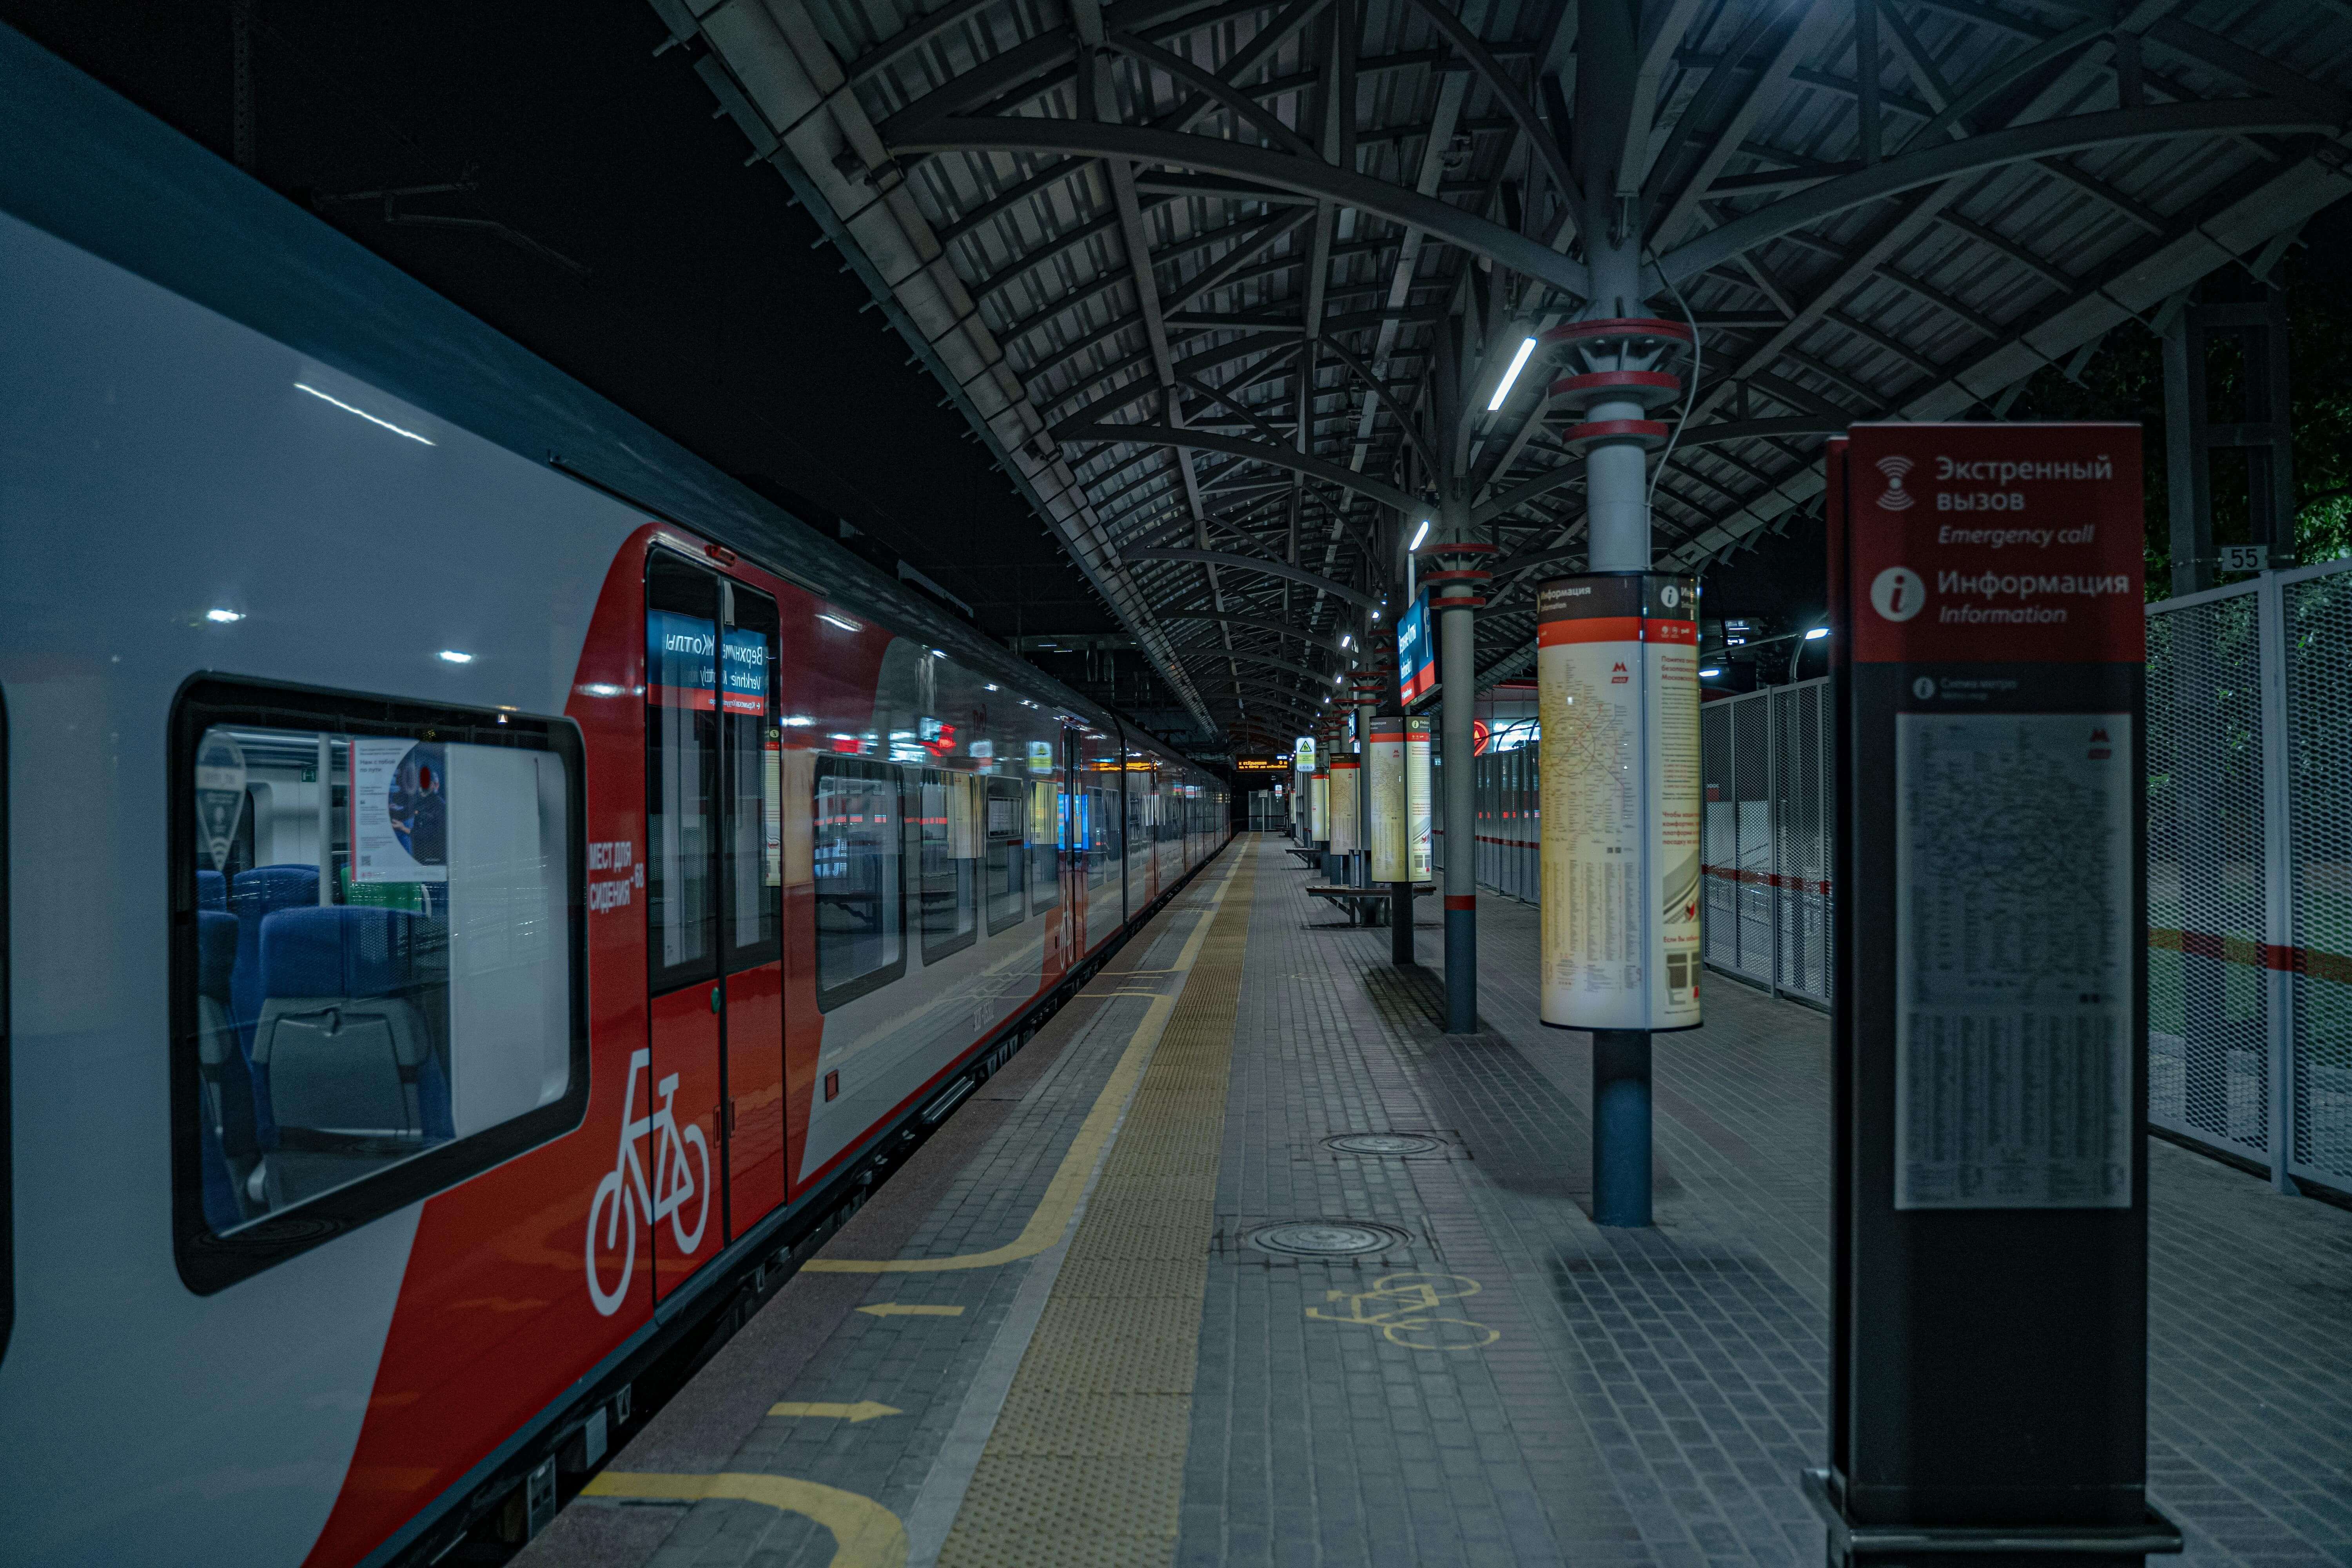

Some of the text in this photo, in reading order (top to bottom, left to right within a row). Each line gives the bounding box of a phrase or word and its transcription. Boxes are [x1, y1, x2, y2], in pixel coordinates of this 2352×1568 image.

[1935, 455, 2112, 485] Экстренный
[1936, 493, 2025, 511] вызов
[1938, 524, 2095, 548] Emergency call
[2231, 549, 2258, 568] 55
[1938, 571, 2130, 600] Информация
[1939, 605, 2068, 624] Information
